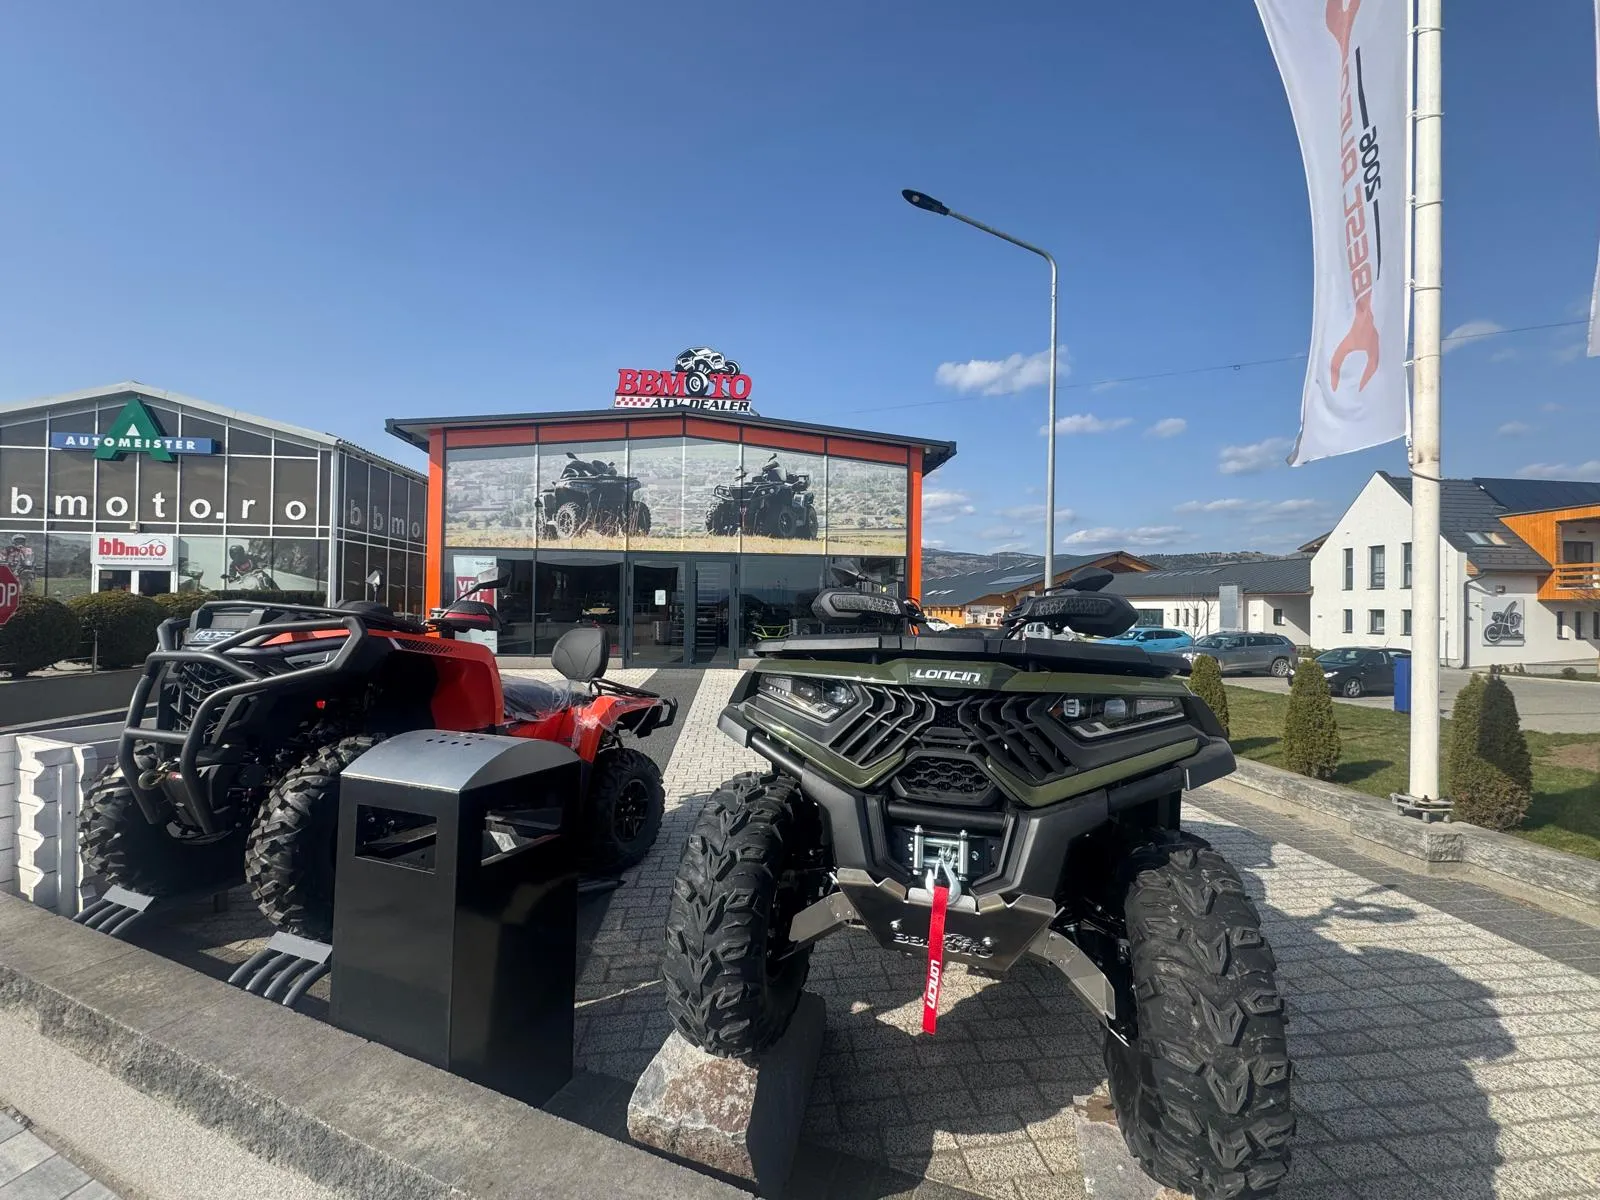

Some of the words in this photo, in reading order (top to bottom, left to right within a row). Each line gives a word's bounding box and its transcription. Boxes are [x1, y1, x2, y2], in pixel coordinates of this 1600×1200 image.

[687, 399, 750, 411] DEALER
[65, 436, 196, 450] AUTOMEISTER
[98, 537, 167, 556] bbmoto
[915, 668, 981, 682] LONCIN
[926, 959, 941, 1010] LONCIN
